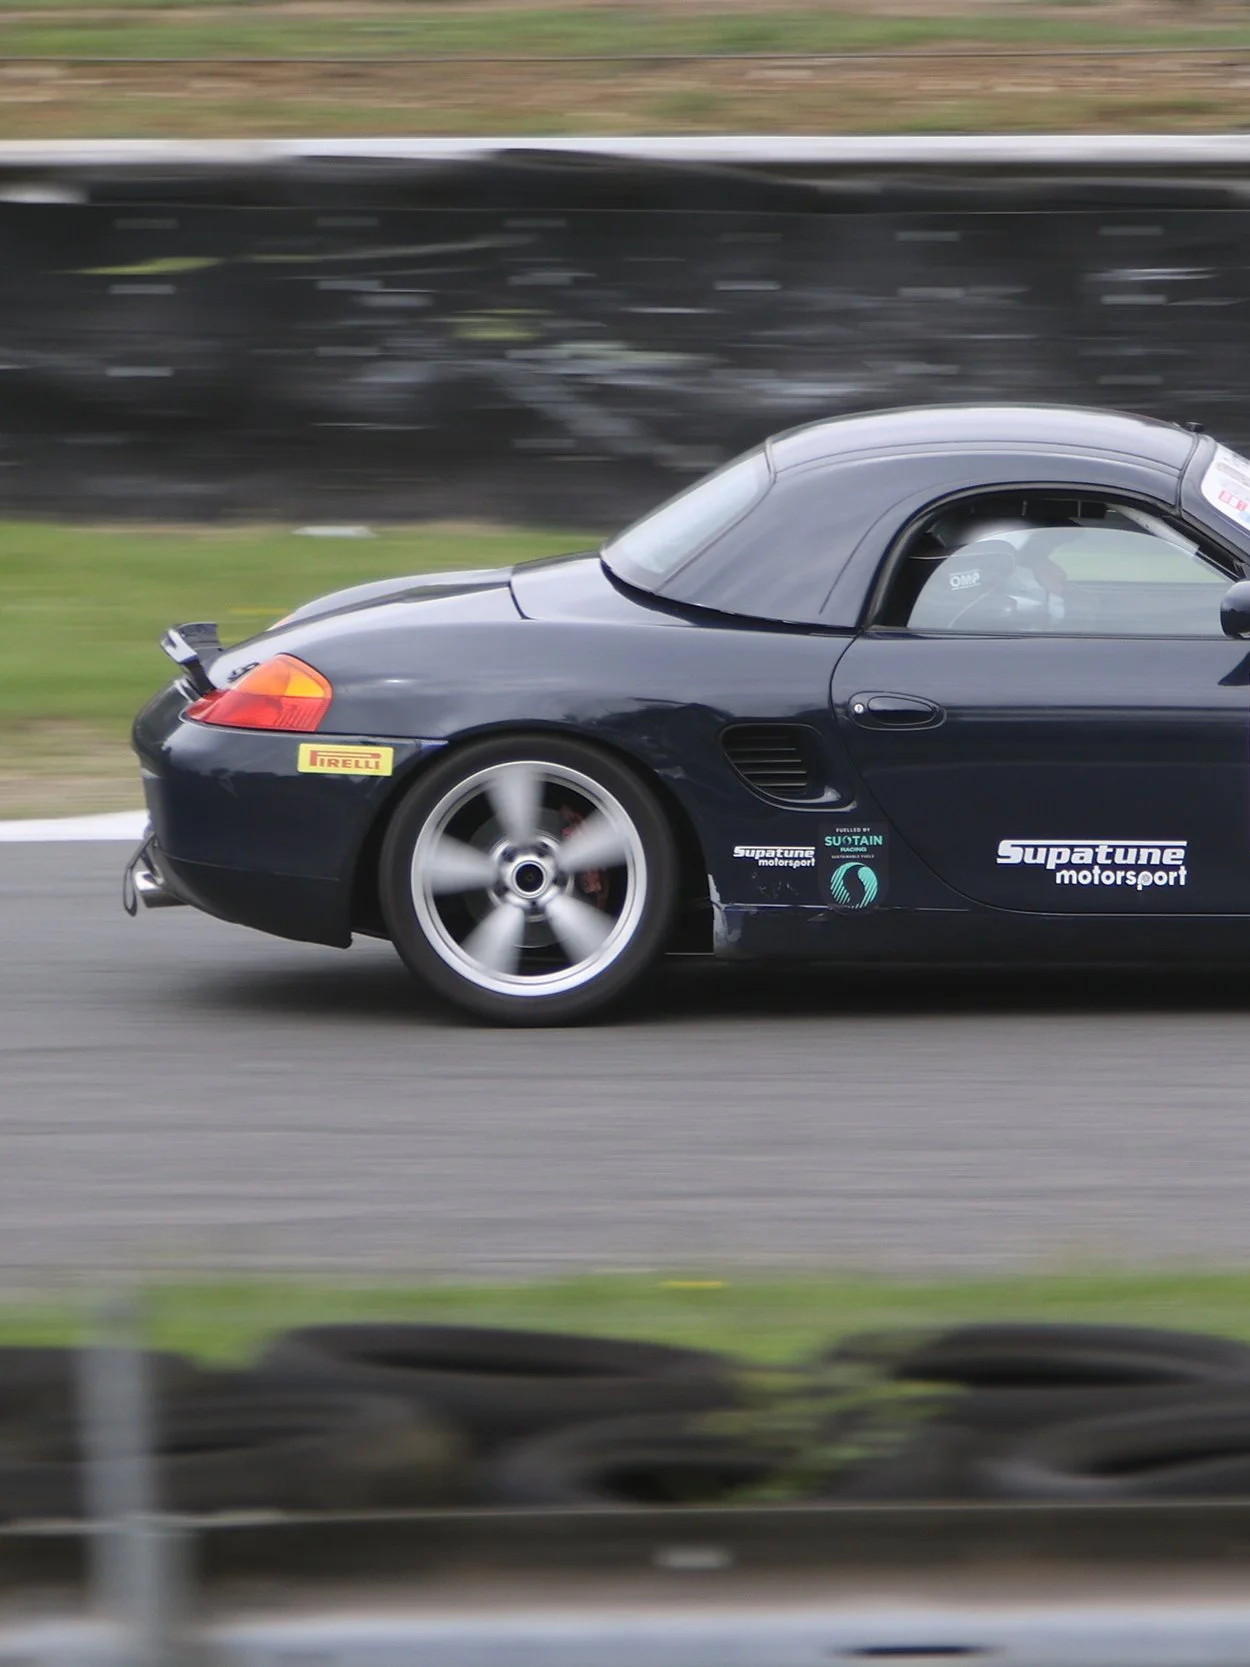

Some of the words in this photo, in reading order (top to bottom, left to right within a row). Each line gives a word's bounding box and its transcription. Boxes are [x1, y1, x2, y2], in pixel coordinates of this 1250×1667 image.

[949, 571, 981, 589] OMP
[310, 750, 381, 770] PIRELLI
[733, 845, 816, 860] Supatune
[996, 839, 1188, 870] Supatune
[758, 857, 816, 869] motorsport
[1055, 865, 1188, 891] motorsport
